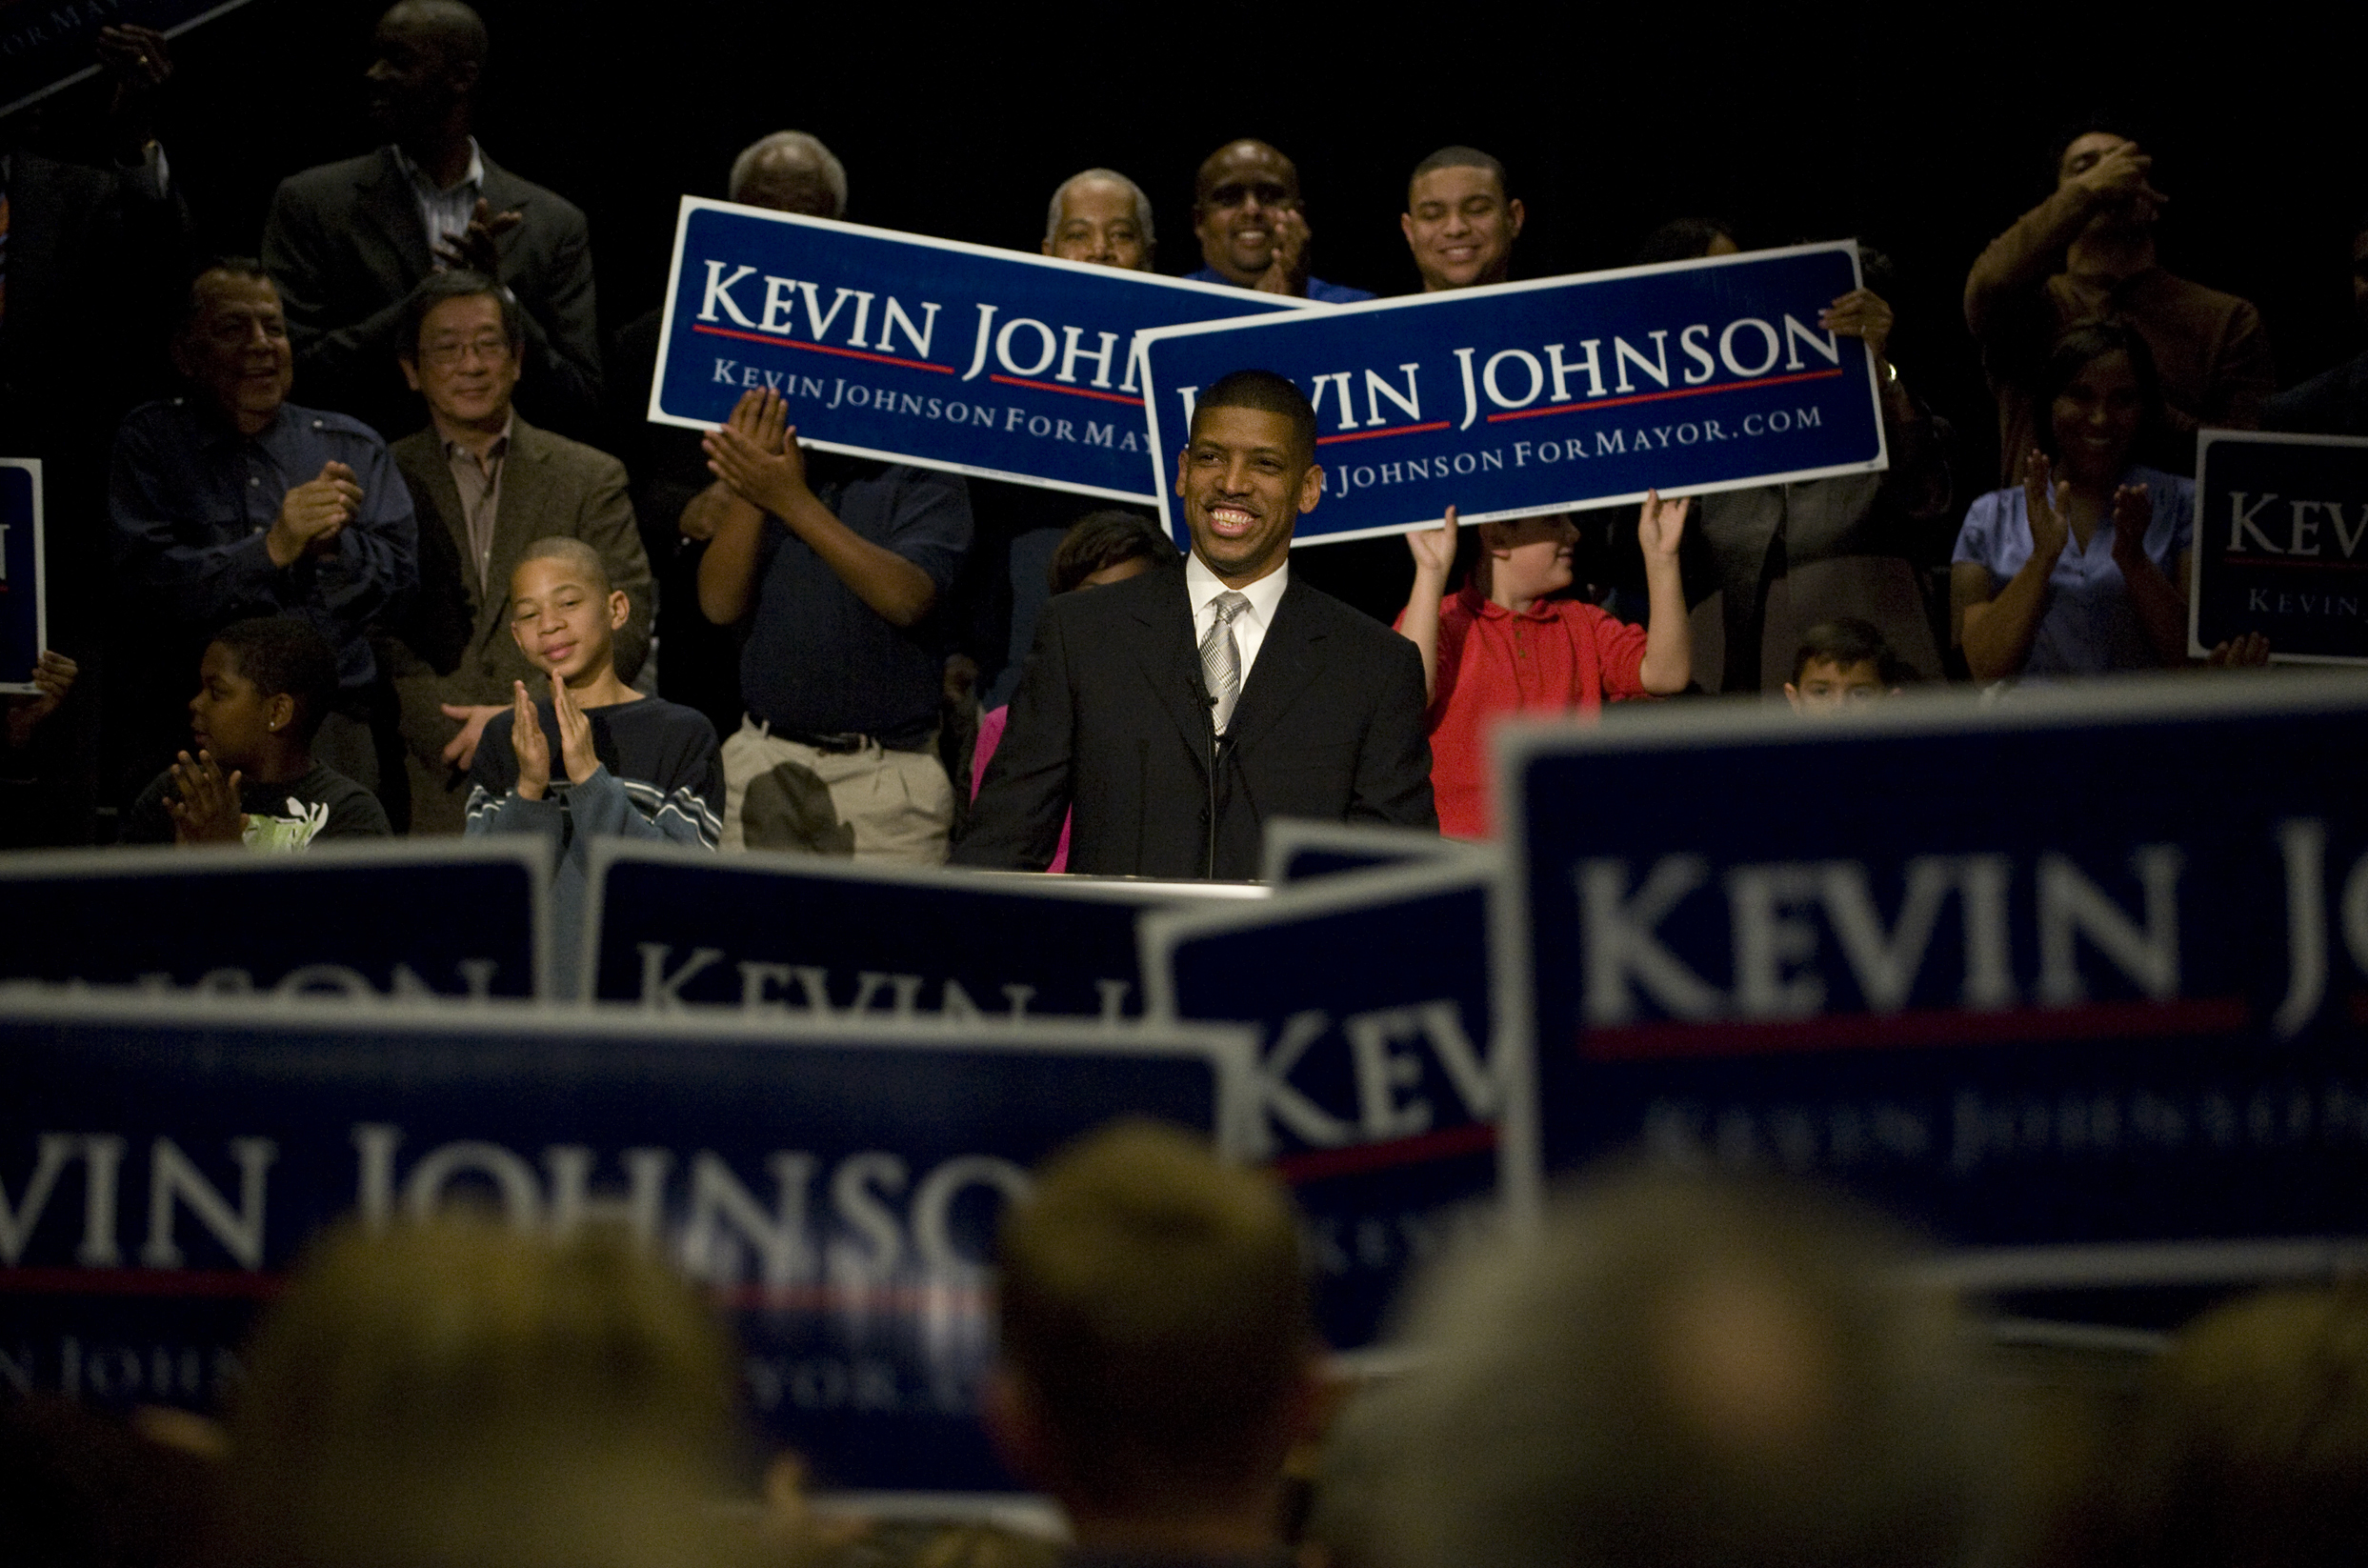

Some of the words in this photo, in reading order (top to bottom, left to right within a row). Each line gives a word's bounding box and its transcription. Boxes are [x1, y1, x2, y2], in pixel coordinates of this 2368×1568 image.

[696, 258, 942, 360] KEVIN
[1453, 312, 1840, 432] JOHNSON
[2247, 587, 2359, 616] KEVIN
[1572, 844, 2188, 1029] KEVIN
